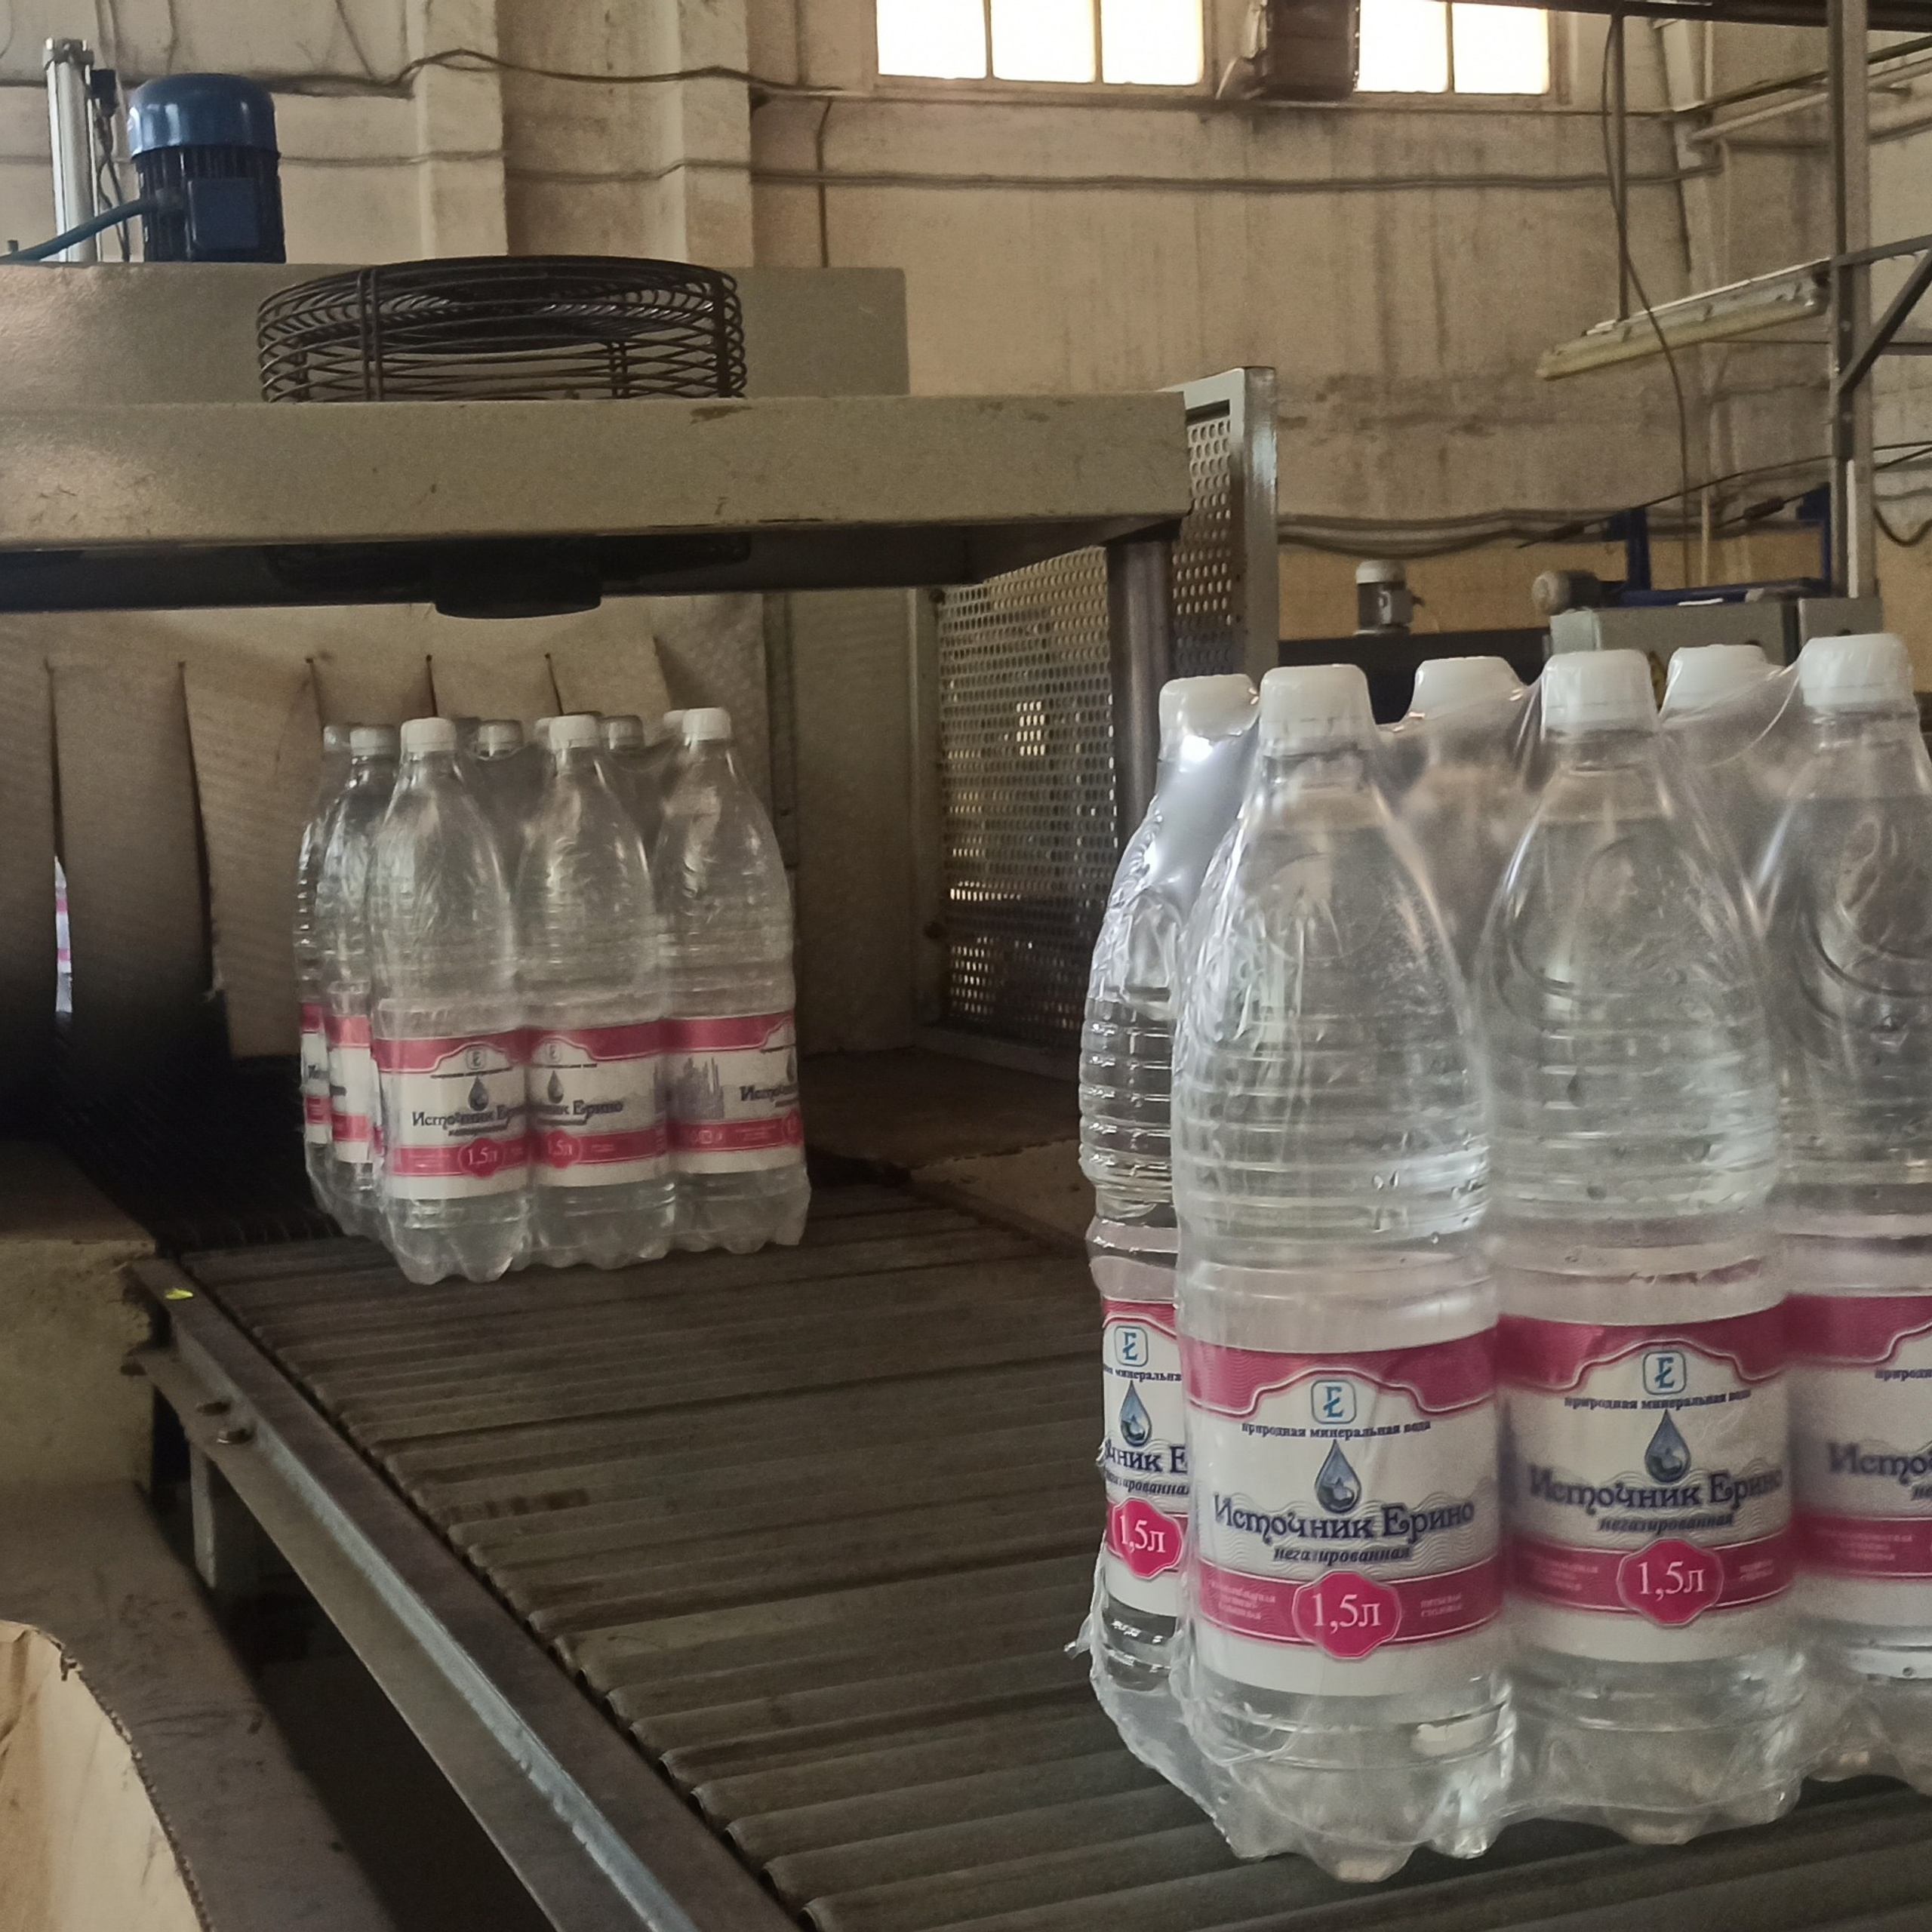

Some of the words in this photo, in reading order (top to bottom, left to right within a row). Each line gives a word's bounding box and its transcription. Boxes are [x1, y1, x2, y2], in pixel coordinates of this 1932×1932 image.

[1241, 1423, 1306, 1438] природная
[1310, 1425, 1401, 1441] минеральная
[1828, 1442, 1932, 1487] Исто
[1530, 1465, 1700, 1515] Источник
[1120, 1515, 1166, 1554] 1,5л
[1214, 1494, 1374, 1545] Источник
[1380, 1500, 1475, 1543] Ерино
[1637, 1561, 1705, 1601] 1,5л
[1312, 1592, 1382, 1634] 1,5л
